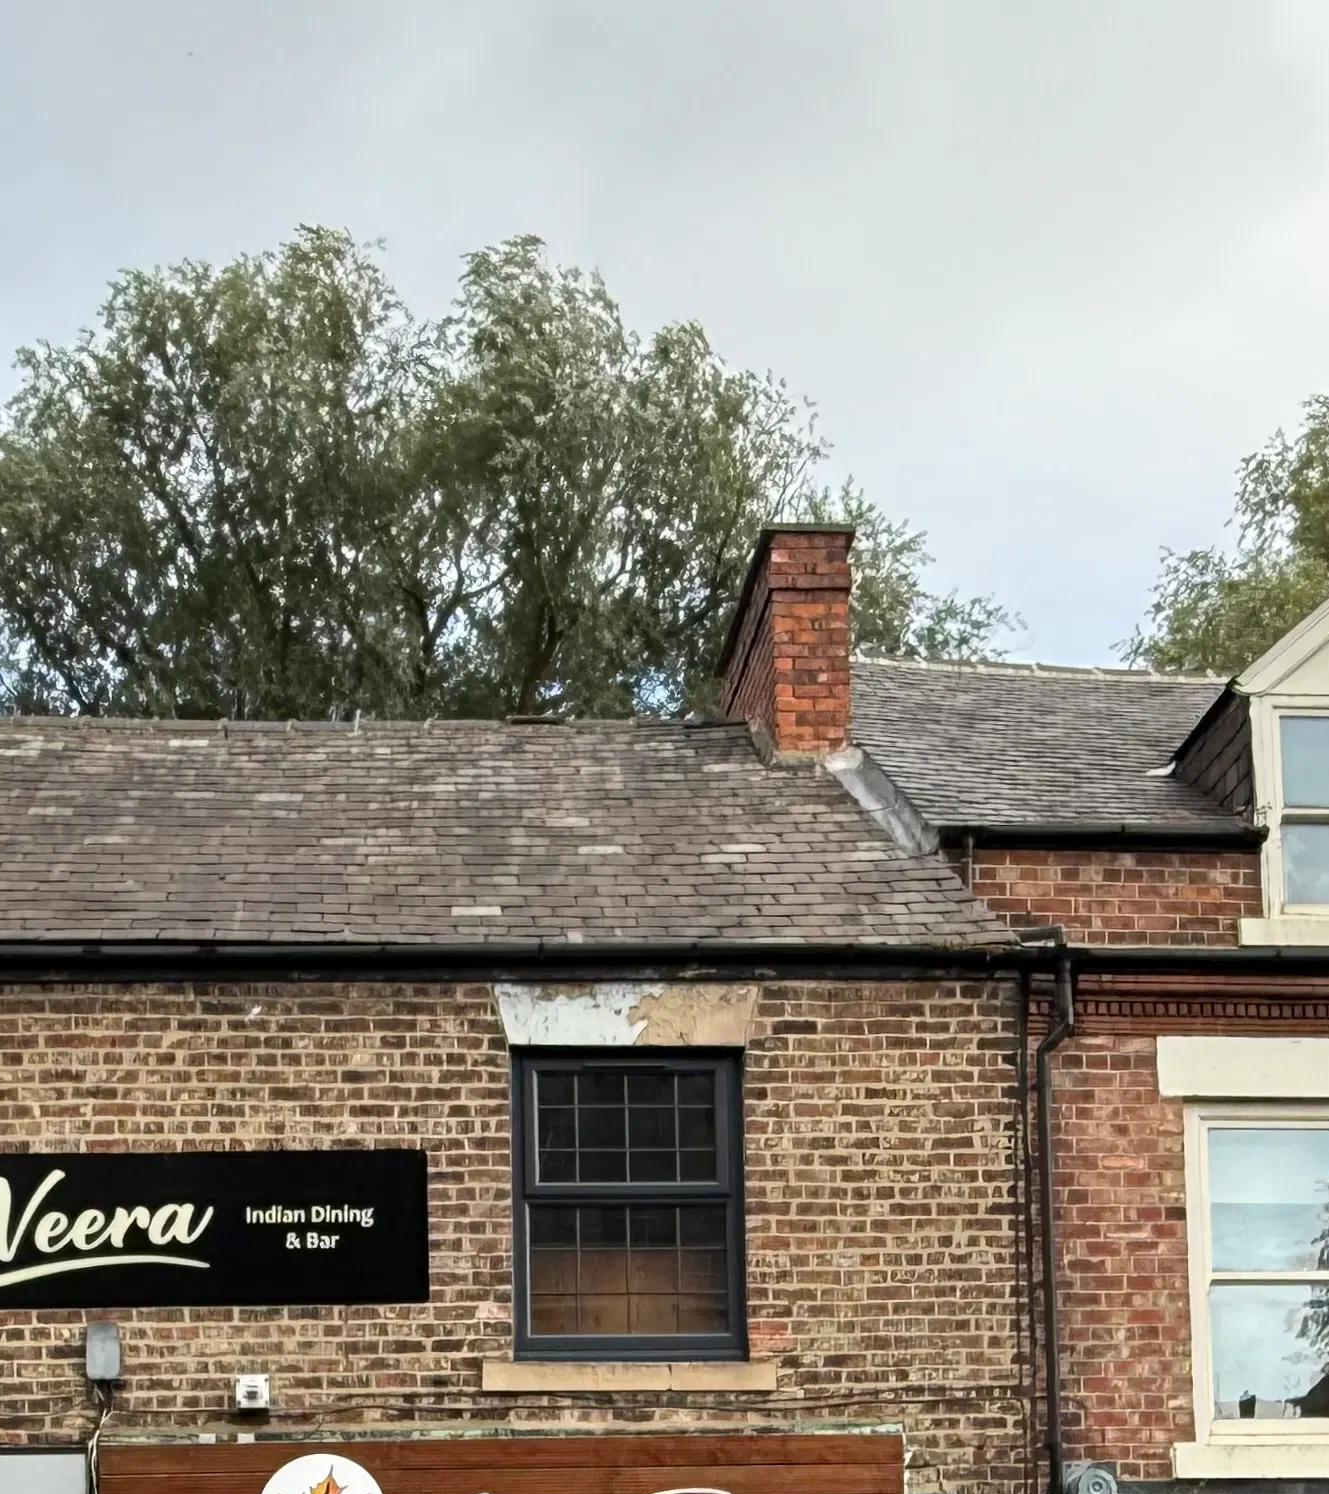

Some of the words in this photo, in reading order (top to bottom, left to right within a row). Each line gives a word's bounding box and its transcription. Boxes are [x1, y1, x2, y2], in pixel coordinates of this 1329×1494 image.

[245, 1204, 306, 1224] Indian
[310, 1204, 374, 1228] Dining
[285, 1231, 301, 1249] &
[306, 1231, 340, 1249] Bar
